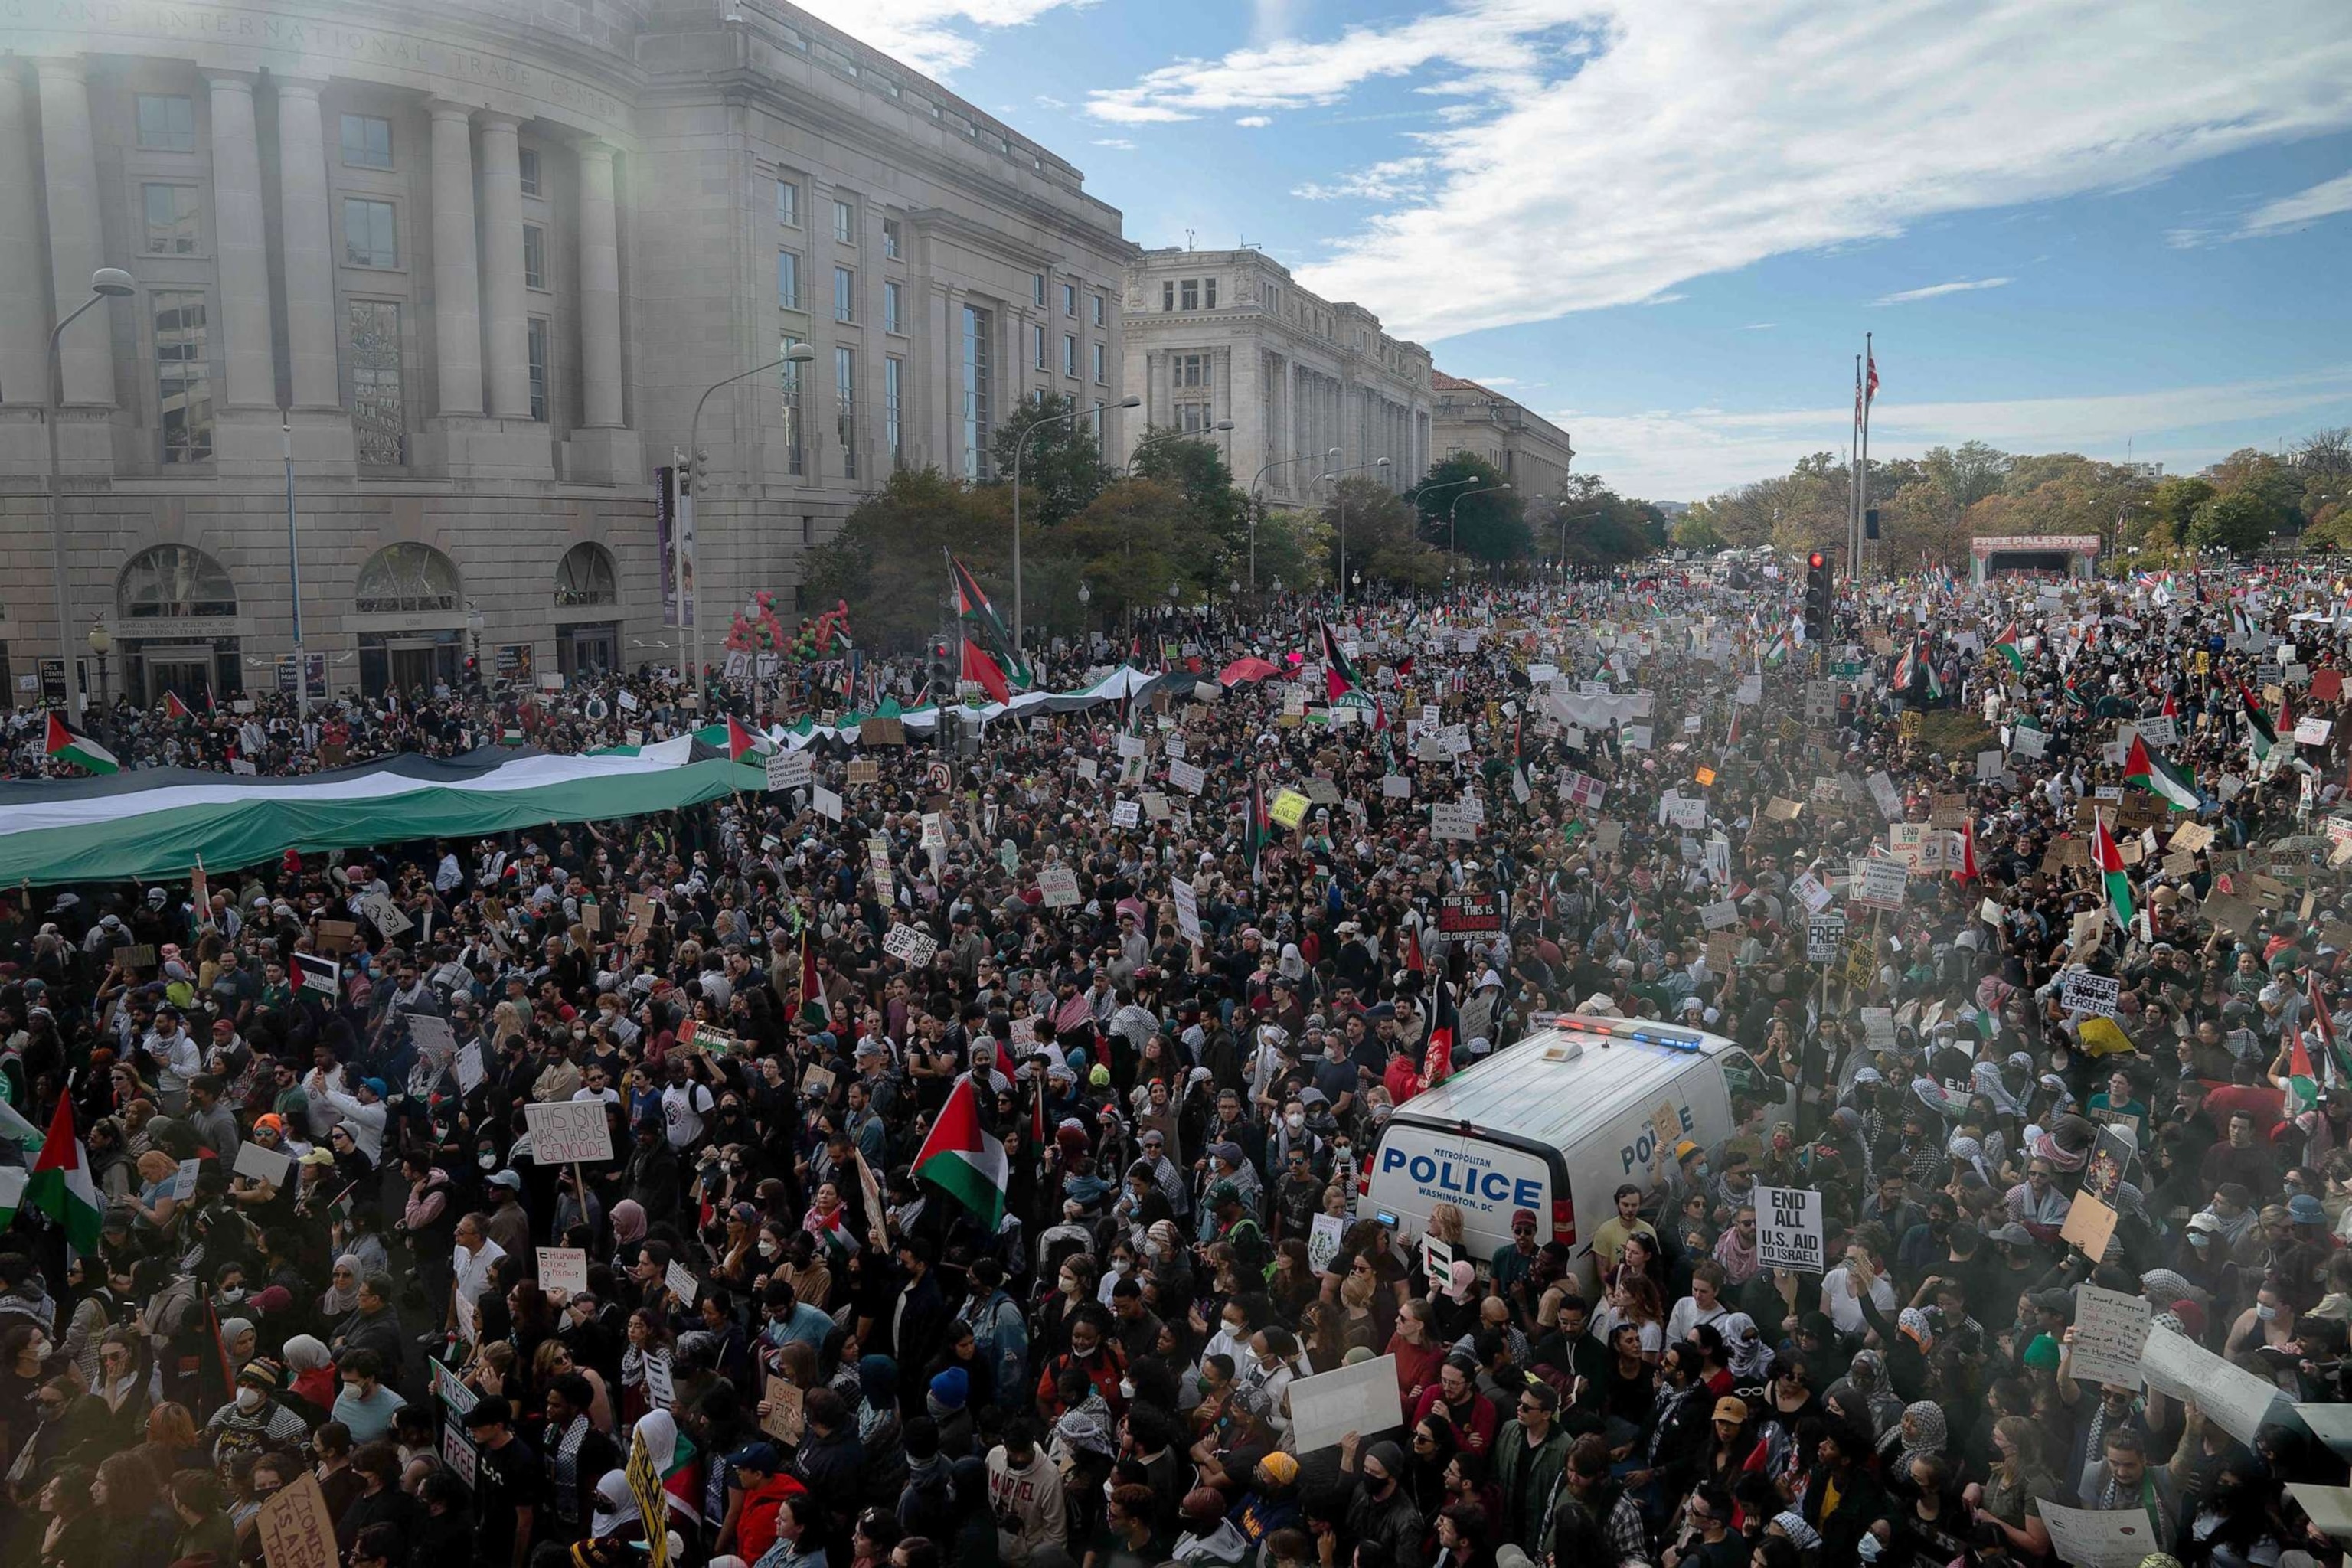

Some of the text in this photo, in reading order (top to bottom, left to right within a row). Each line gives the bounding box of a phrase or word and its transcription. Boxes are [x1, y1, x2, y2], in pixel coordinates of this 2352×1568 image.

[156, 9, 428, 63] INTERNATIONAL
[454, 52, 531, 87] TRADE
[550, 79, 616, 118] CENTER
[2012, 536, 2099, 544] PALESTINE
[1902, 827, 1919, 835] END
[1050, 874, 1067, 883] END
[1441, 897, 1462, 907] THIS
[1464, 896, 1472, 906] IS
[1463, 905, 1494, 916] THIS IS
[1441, 916, 1500, 930] GENOCIDE
[894, 924, 937, 950] GENOCIDE
[1451, 931, 1485, 940] CEASEFIRE
[1808, 925, 1844, 945] FREE
[1840, 937, 1857, 951] END
[886, 942, 906, 957] GOT
[890, 935, 931, 959] JOE HAS
[1808, 945, 1838, 954] PALESTIN
[2066, 972, 2119, 993] CEASEFIRE
[2063, 995, 2115, 1017] CEASEFIRE
[526, 1106, 567, 1129] THIS
[530, 1124, 606, 1146] WAR THIS IS
[540, 1141, 607, 1162] GENOCIDE
[1433, 1147, 1492, 1168] METROPOLITAN
[1383, 1147, 1543, 1210] POLICE
[1481, 1200, 1494, 1213] DC
[1771, 1190, 1806, 1210] END
[1775, 1209, 1805, 1229] ALL
[1762, 1230, 1819, 1250] U.S. AID
[1761, 1246, 1819, 1263] TO ISRAEL!
[773, 1383, 797, 1408] CEASE
[769, 1418, 792, 1439] NOW
[446, 1431, 473, 1484] FREE
